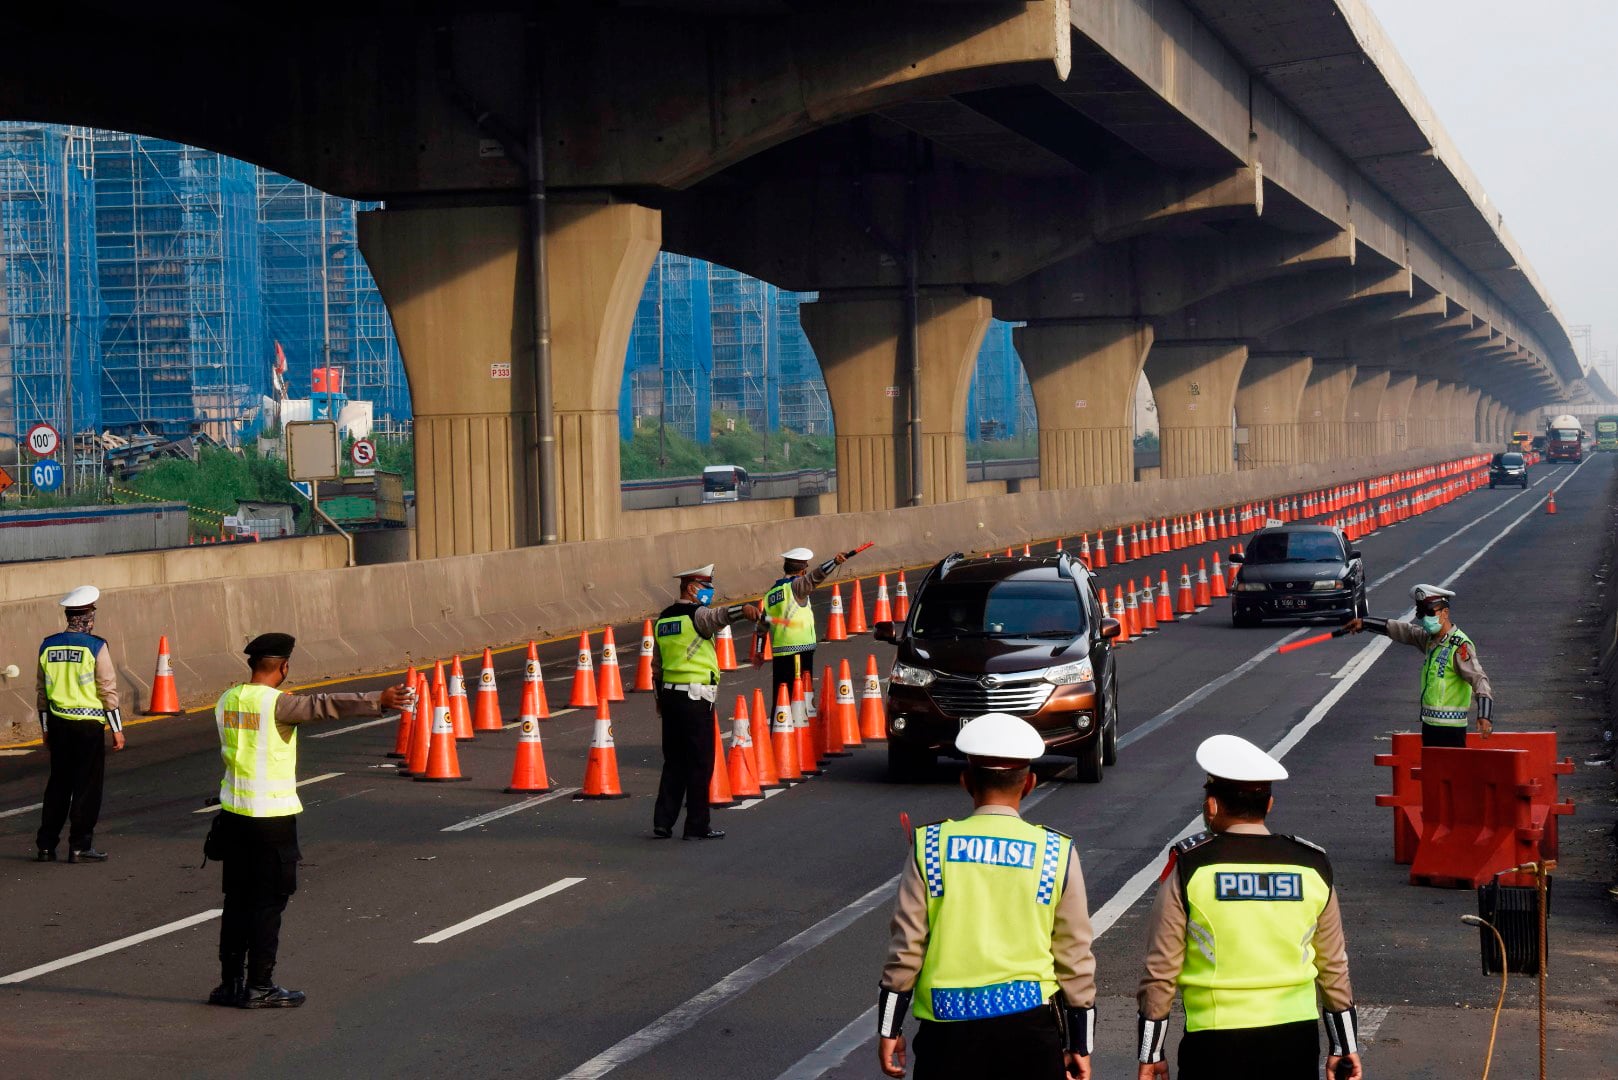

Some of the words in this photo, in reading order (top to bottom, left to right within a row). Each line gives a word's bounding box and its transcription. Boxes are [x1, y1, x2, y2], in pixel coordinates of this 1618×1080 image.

[33, 434, 48, 448] 100
[34, 465, 53, 486] 60
[48, 649, 83, 663] POLISI
[949, 837, 1035, 868] POLISI
[1219, 874, 1300, 897] POLISI
